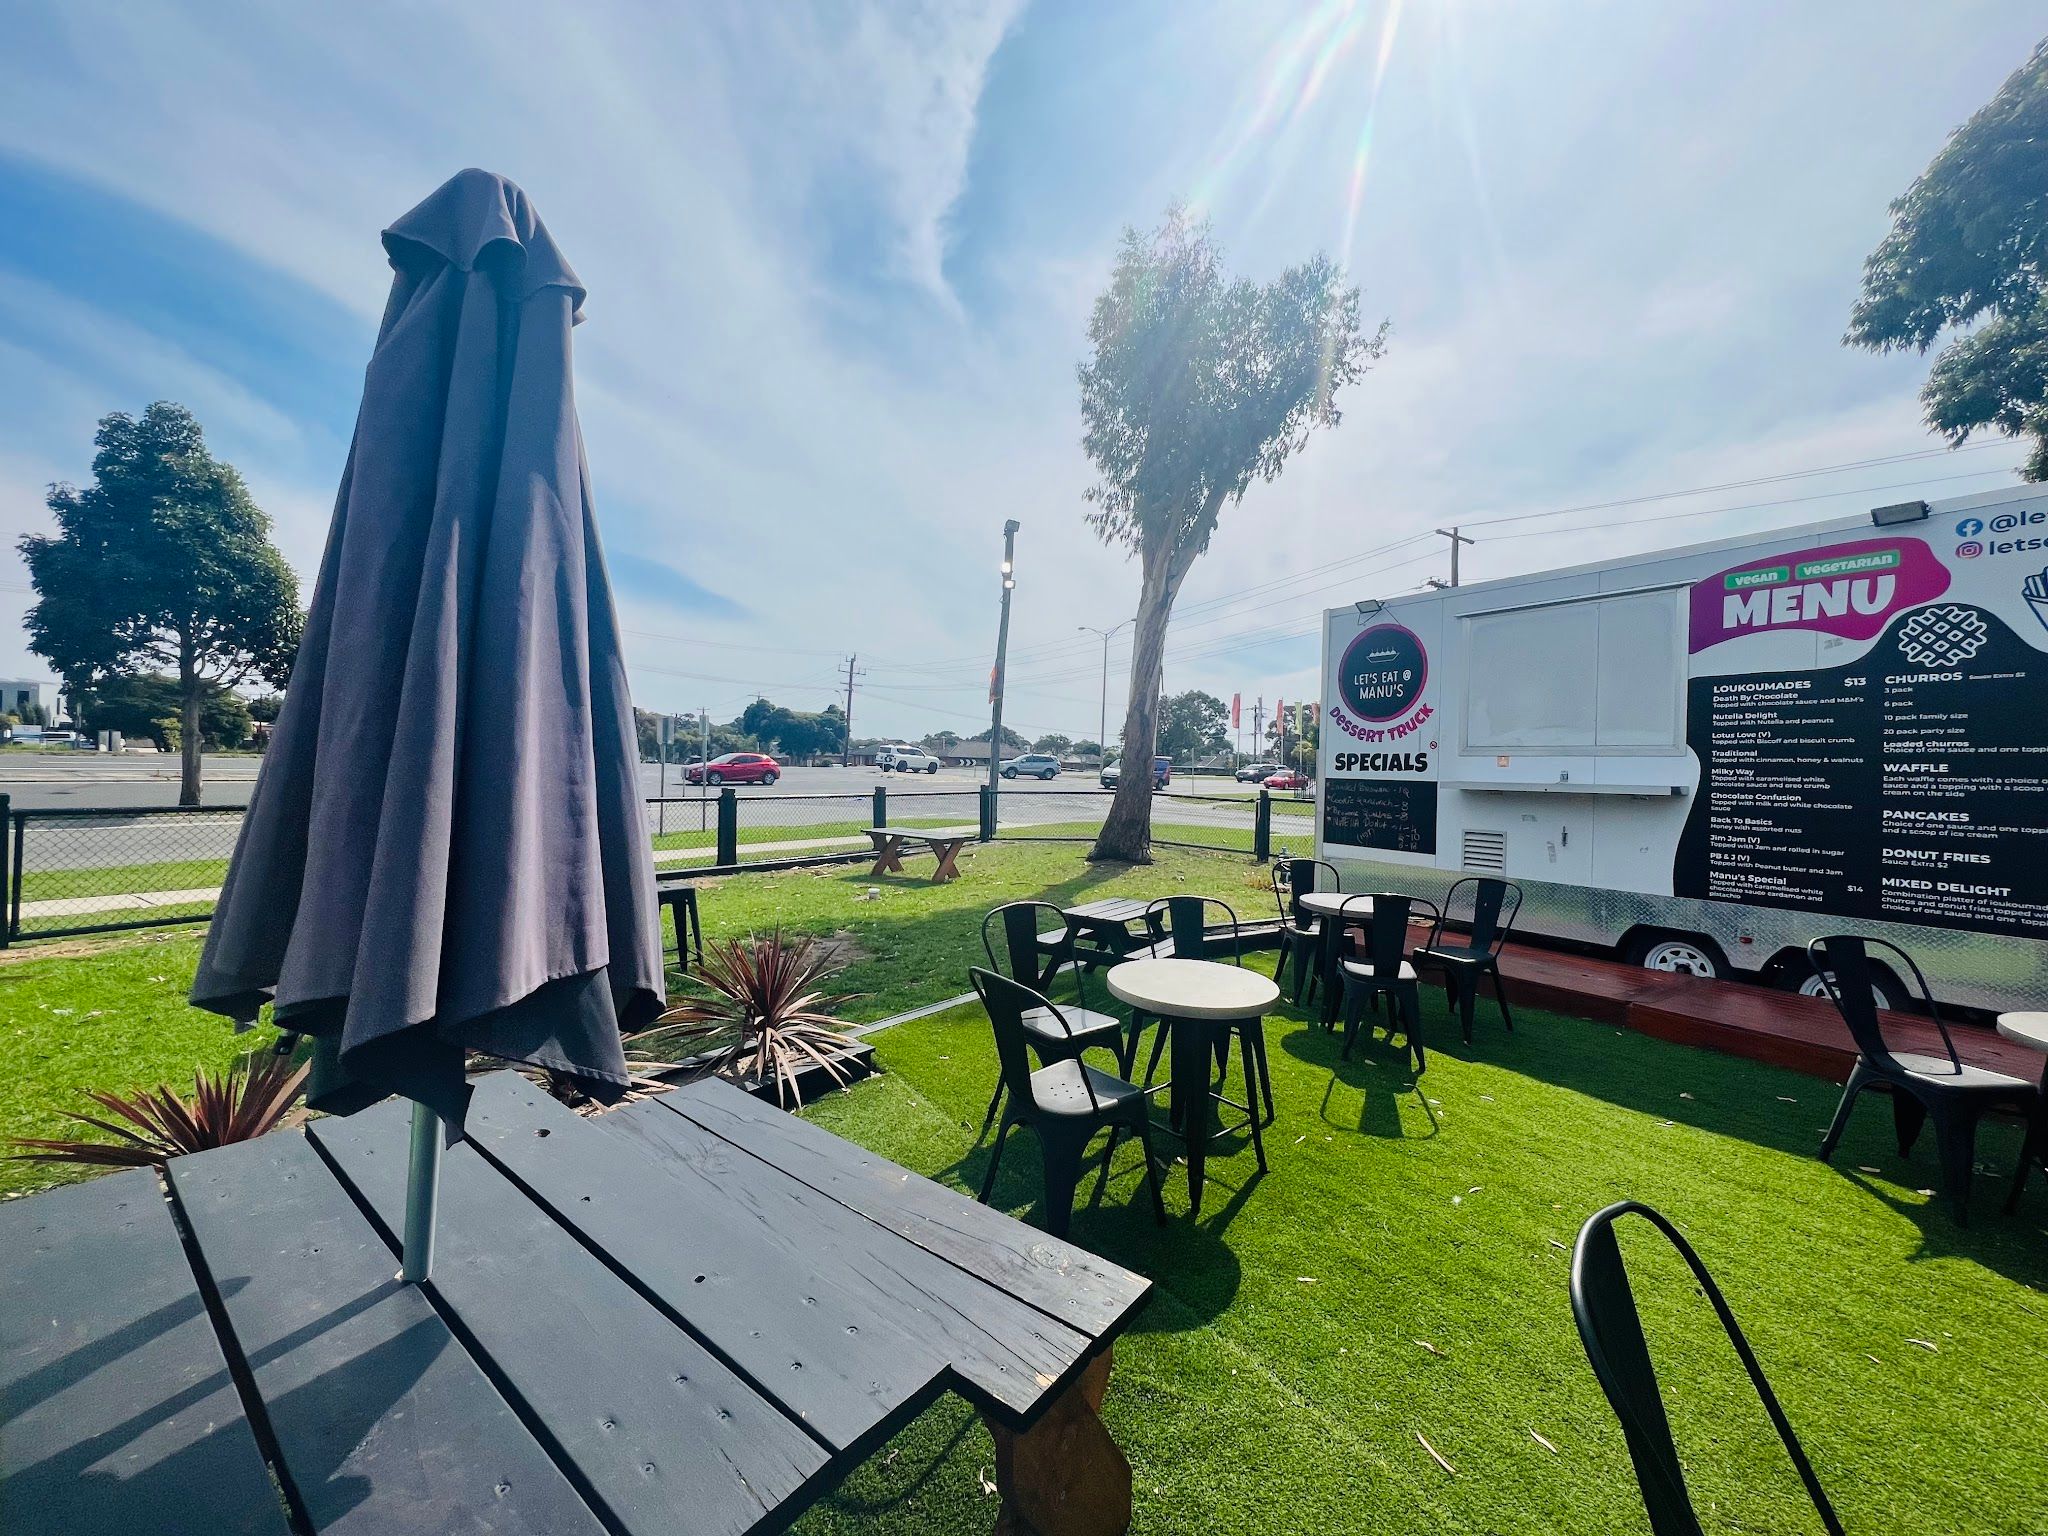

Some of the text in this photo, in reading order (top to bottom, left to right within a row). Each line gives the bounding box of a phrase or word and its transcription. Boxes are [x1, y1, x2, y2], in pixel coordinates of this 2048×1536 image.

[1989, 511, 2048, 532] @le
[1722, 574, 1896, 629] MENU
[1355, 670, 1412, 685] LET'S EAT @
[1885, 672, 1963, 684] CHURROS
[1359, 684, 1404, 699] MANU'S
[1713, 677, 1866, 693] LOUKOUMADES $13
[1892, 686, 1913, 694] pack
[1892, 700, 1913, 708] pack
[1387, 703, 1434, 741] TRUCK
[1335, 752, 1428, 772] SPECIALS
[1883, 764, 1949, 772] WAFFLE
[1939, 783, 1976, 791] topping
[1883, 810, 1970, 821] PANCAKES
[1882, 848, 1991, 864] DONUT FRIES
[1882, 858, 1908, 866] Sauce
[1710, 871, 1786, 884] Manu's Special
[1882, 878, 2011, 896] MIXED DELIGHT
[1882, 890, 1940, 900] Combination
[1943, 895, 1974, 904] platter
